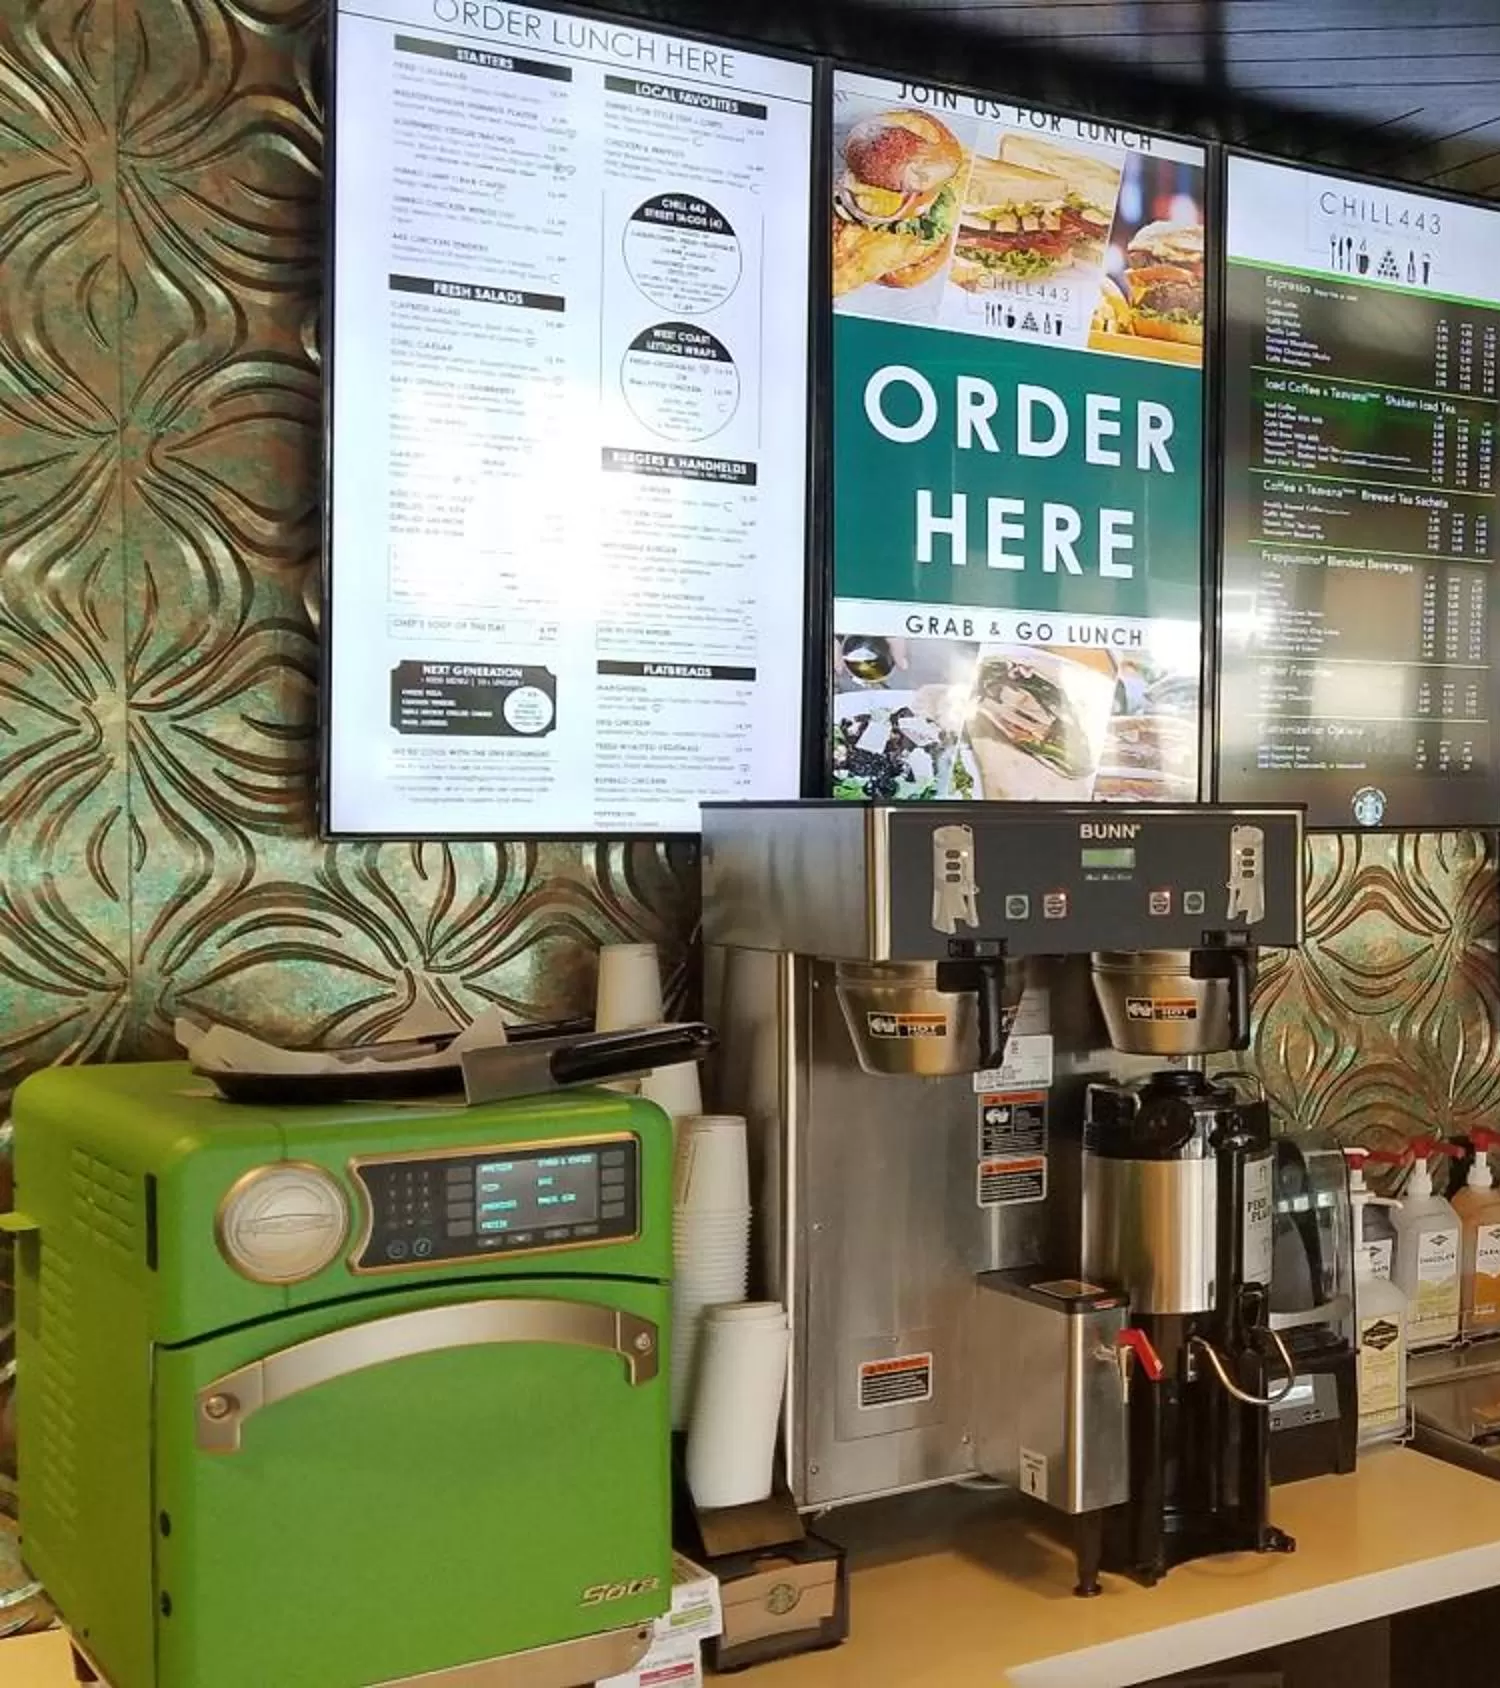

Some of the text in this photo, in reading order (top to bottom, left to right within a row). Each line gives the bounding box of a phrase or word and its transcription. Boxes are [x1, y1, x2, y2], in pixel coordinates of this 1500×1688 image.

[433, 0, 735, 78] ORDER LUNCH HERE
[457, 49, 514, 69] STARTERS
[635, 82, 739, 114] LOCAL FAVORITES
[897, 81, 1152, 152] JOIN US FOR LUNCH
[661, 199, 687, 212] CHILL
[1319, 191, 1442, 235] CHILL443
[676, 214, 707, 228] TACOS
[433, 281, 524, 305] FRESH SALADS
[1265, 275, 1311, 295] Espresso
[678, 333, 711, 345] COAST
[1265, 377, 1286, 391] Iced
[1288, 381, 1320, 396] Coffee
[1420, 400, 1438, 412] Iced
[1440, 402, 1456, 414] Tea
[864, 364, 1176, 473] ORDER
[679, 458, 747, 475] HANDHELDS
[1264, 479, 1296, 493] Coffee
[1398, 492, 1413, 505] Tea
[915, 489, 1136, 580] HERE
[905, 614, 1143, 647] GRAB & GO LUNCH
[422, 665, 523, 678] NEXT GENERATION
[643, 664, 712, 678] FLATBREADS
